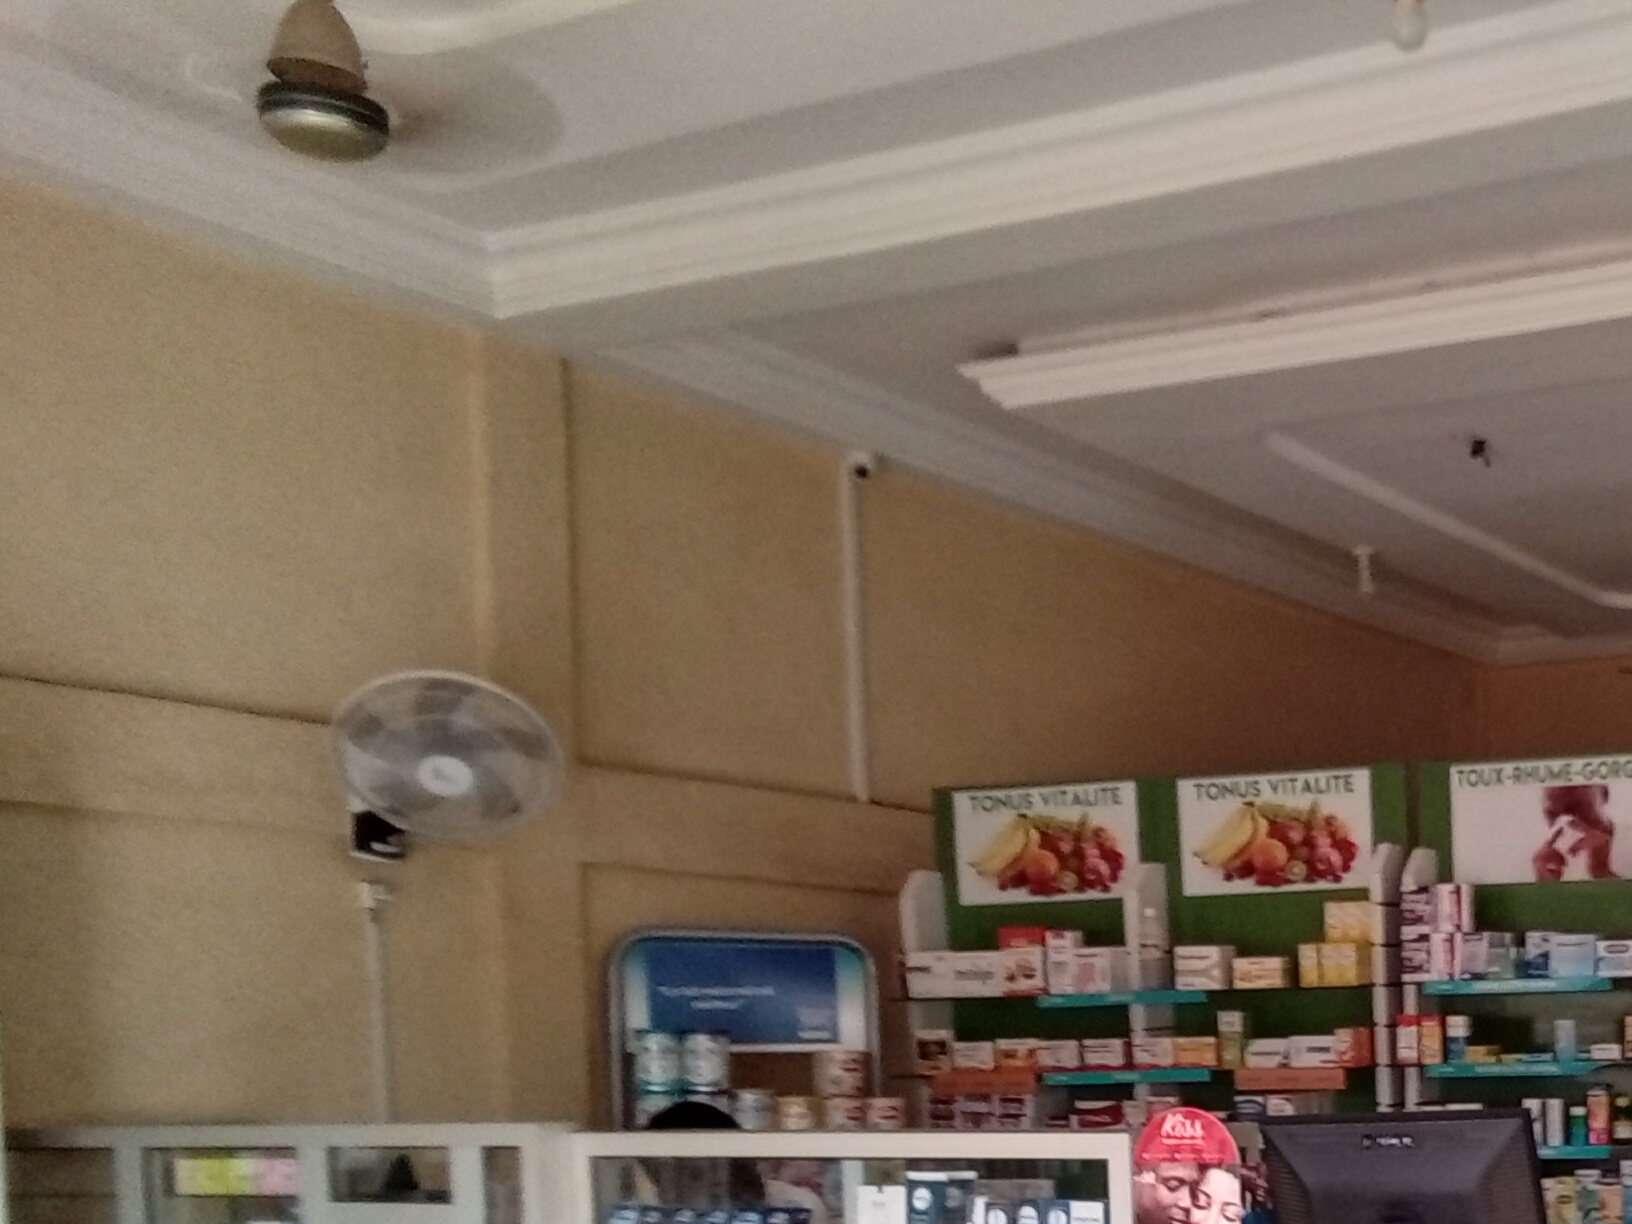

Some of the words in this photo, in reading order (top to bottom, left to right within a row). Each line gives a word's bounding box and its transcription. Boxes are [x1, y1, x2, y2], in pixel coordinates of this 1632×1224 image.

[969, 790, 1034, 813] TONUS
[1039, 786, 1123, 809] VITALITE
[1193, 780, 1262, 802] TONUS
[1267, 774, 1355, 797] VITALITE
